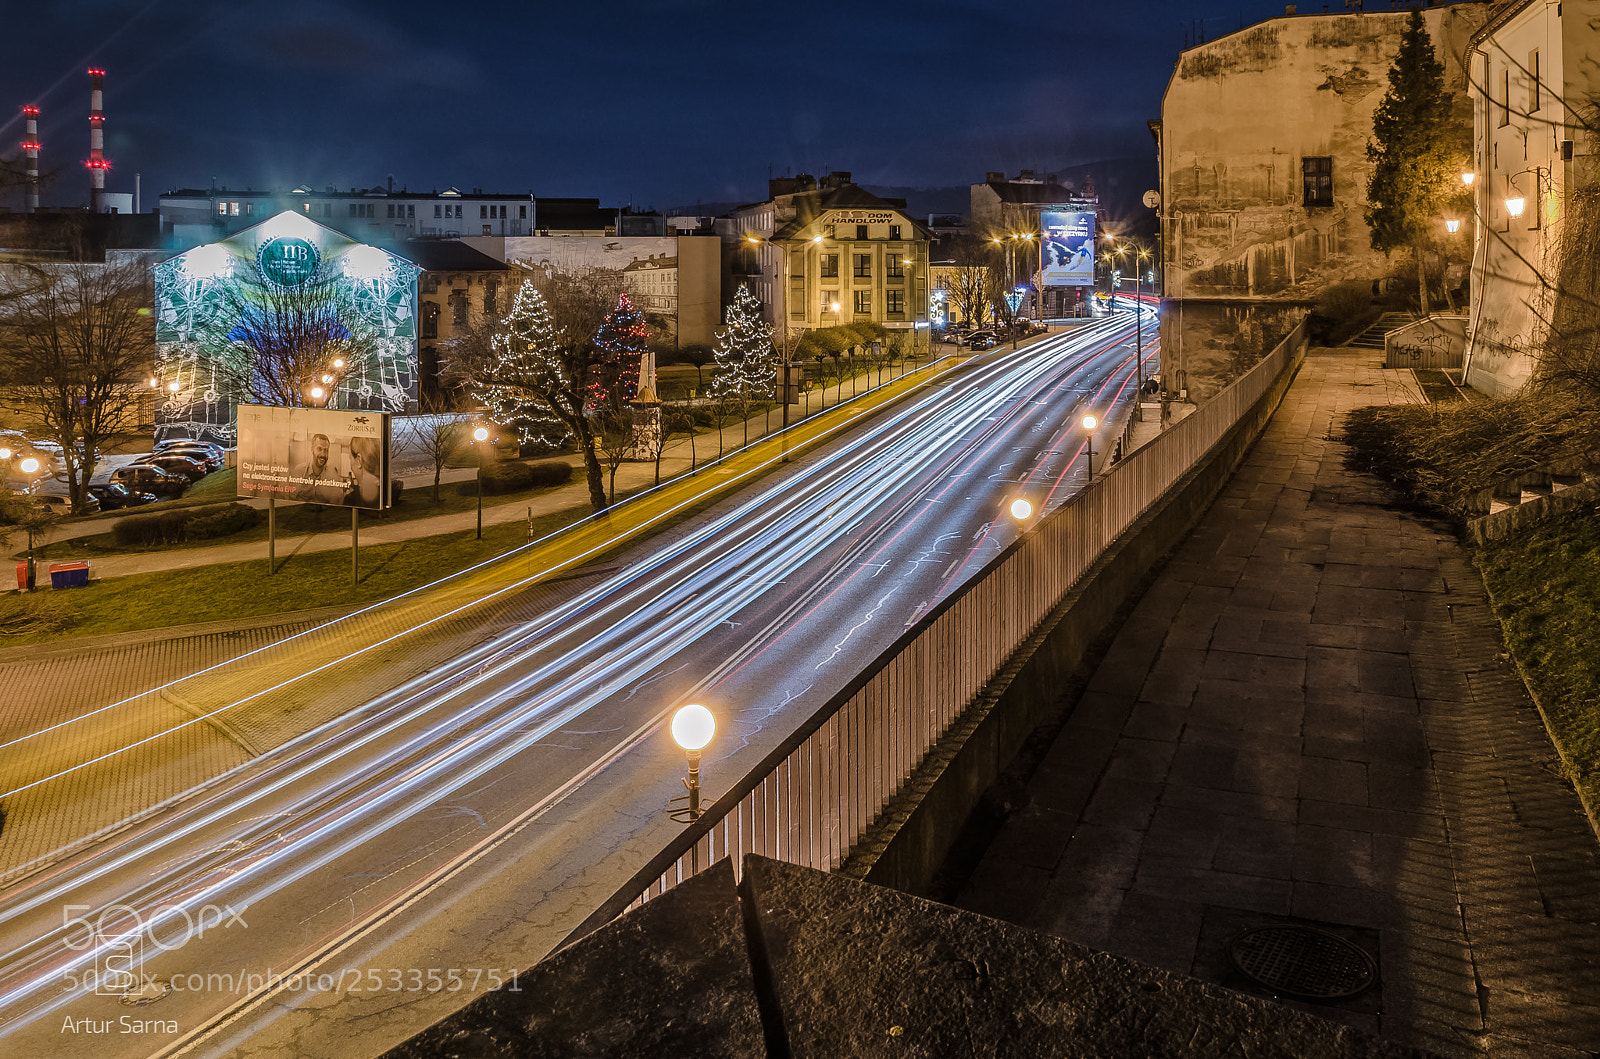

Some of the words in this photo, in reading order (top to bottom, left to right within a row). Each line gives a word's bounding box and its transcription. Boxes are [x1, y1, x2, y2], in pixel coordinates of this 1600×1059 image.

[242, 462, 253, 471] Czy
[253, 463, 270, 472] jesteś
[270, 465, 289, 473] gotów
[242, 481, 256, 491] Sage
[284, 485, 297, 493] ERP
[288, 475, 314, 485] kontrole
[314, 478, 352, 489] podatkowe?
